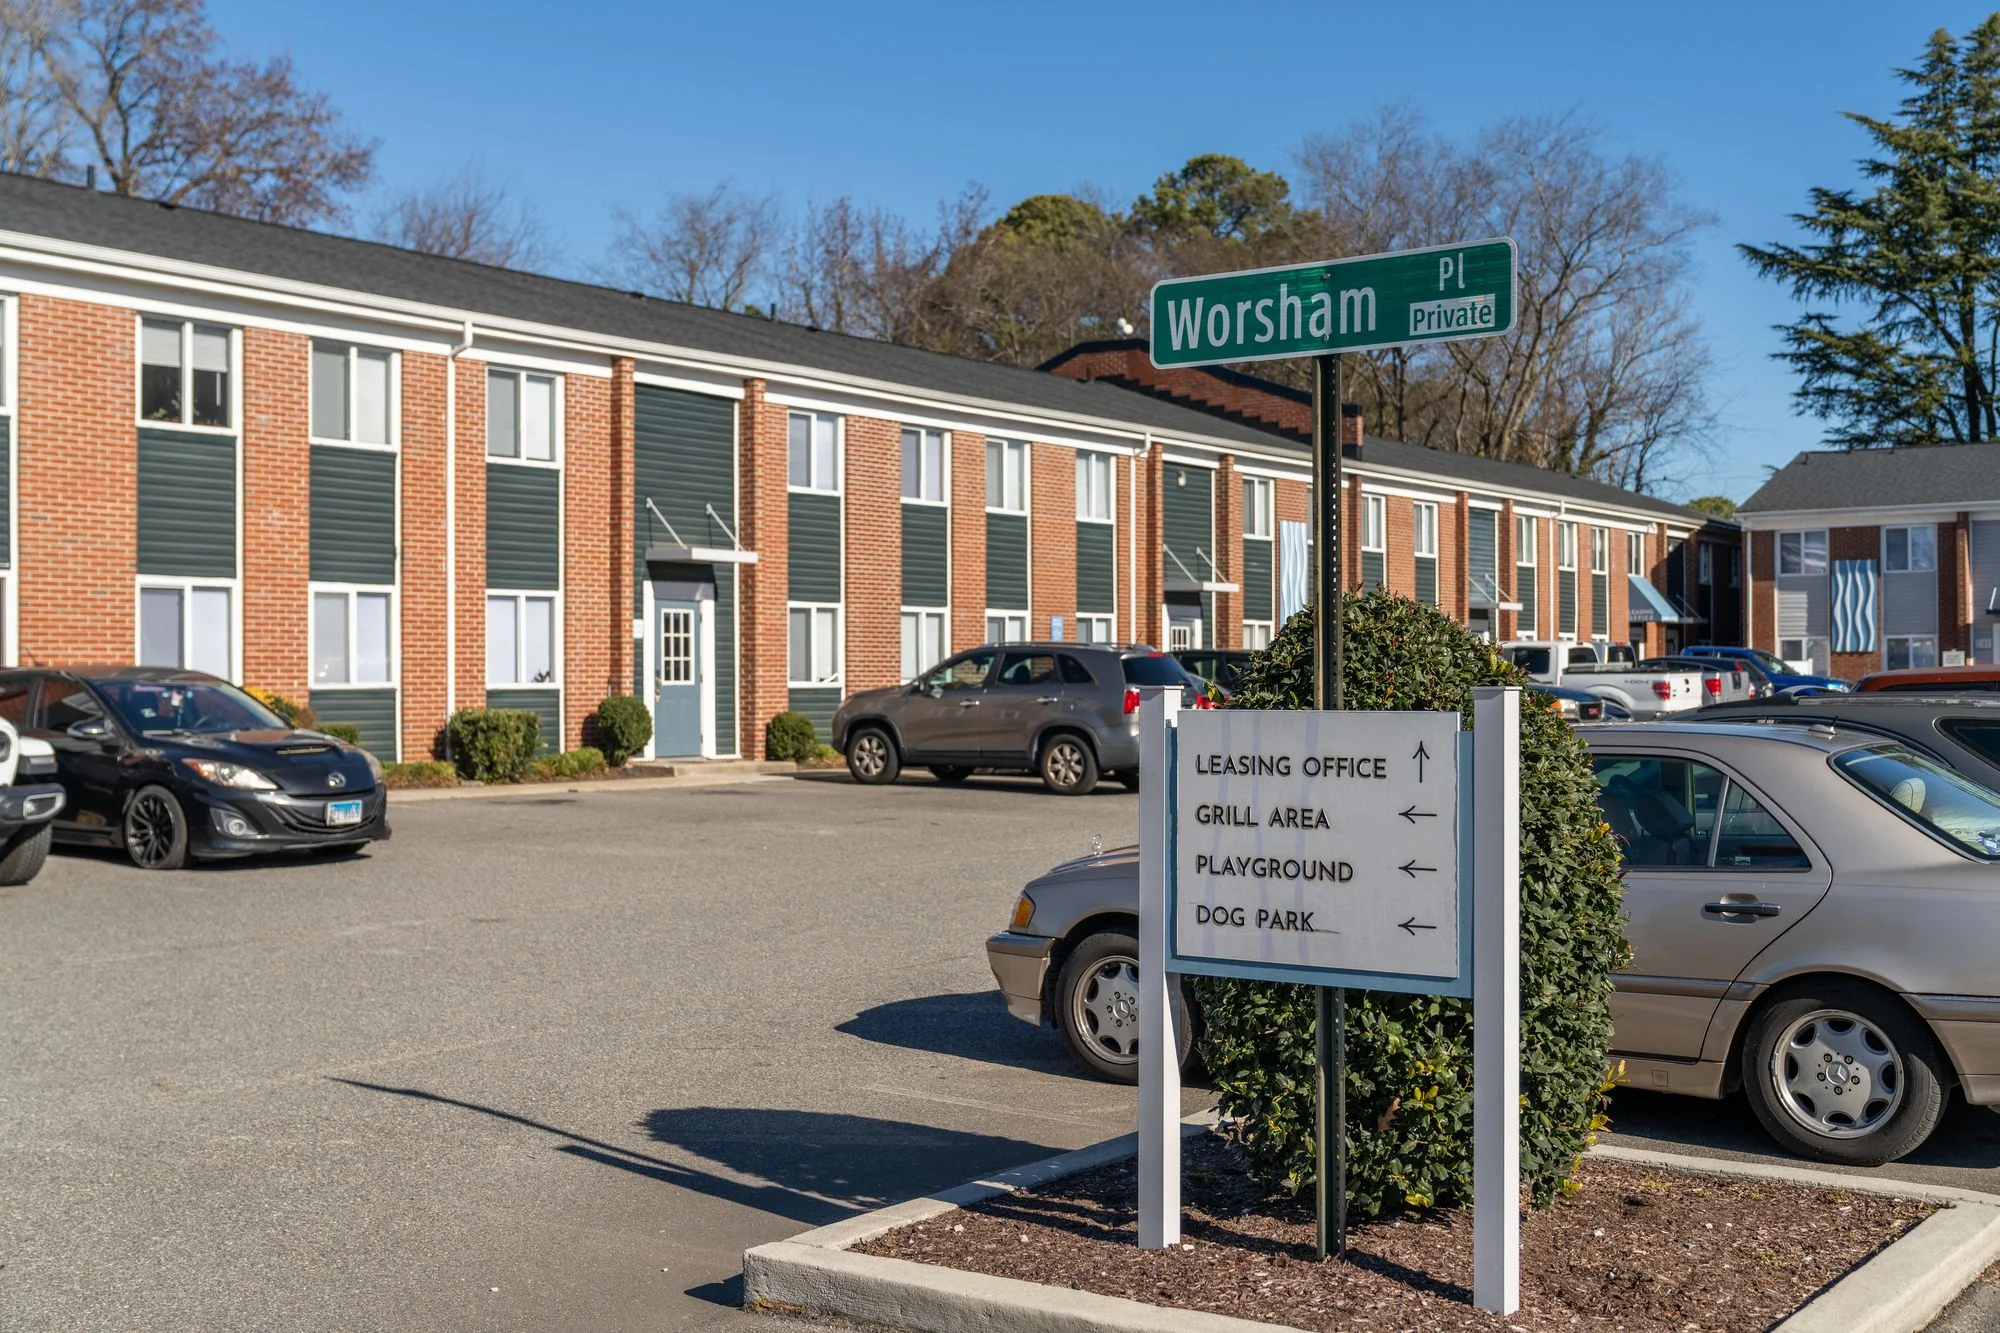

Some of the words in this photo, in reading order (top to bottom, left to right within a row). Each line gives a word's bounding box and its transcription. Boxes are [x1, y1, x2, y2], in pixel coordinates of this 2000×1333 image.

[1439, 252, 1466, 291] Pl
[1167, 283, 1376, 351] Worsham
[1413, 302, 1493, 332] Private
[1195, 754, 1291, 776] LEASING
[1303, 757, 1387, 778] OFFICE
[1195, 805, 1258, 827] GRILL
[1269, 807, 1330, 829] AREA
[1195, 855, 1354, 882] PLAYGROUND
[1195, 905, 1245, 927] DOG
[1256, 909, 1315, 932] PARK
